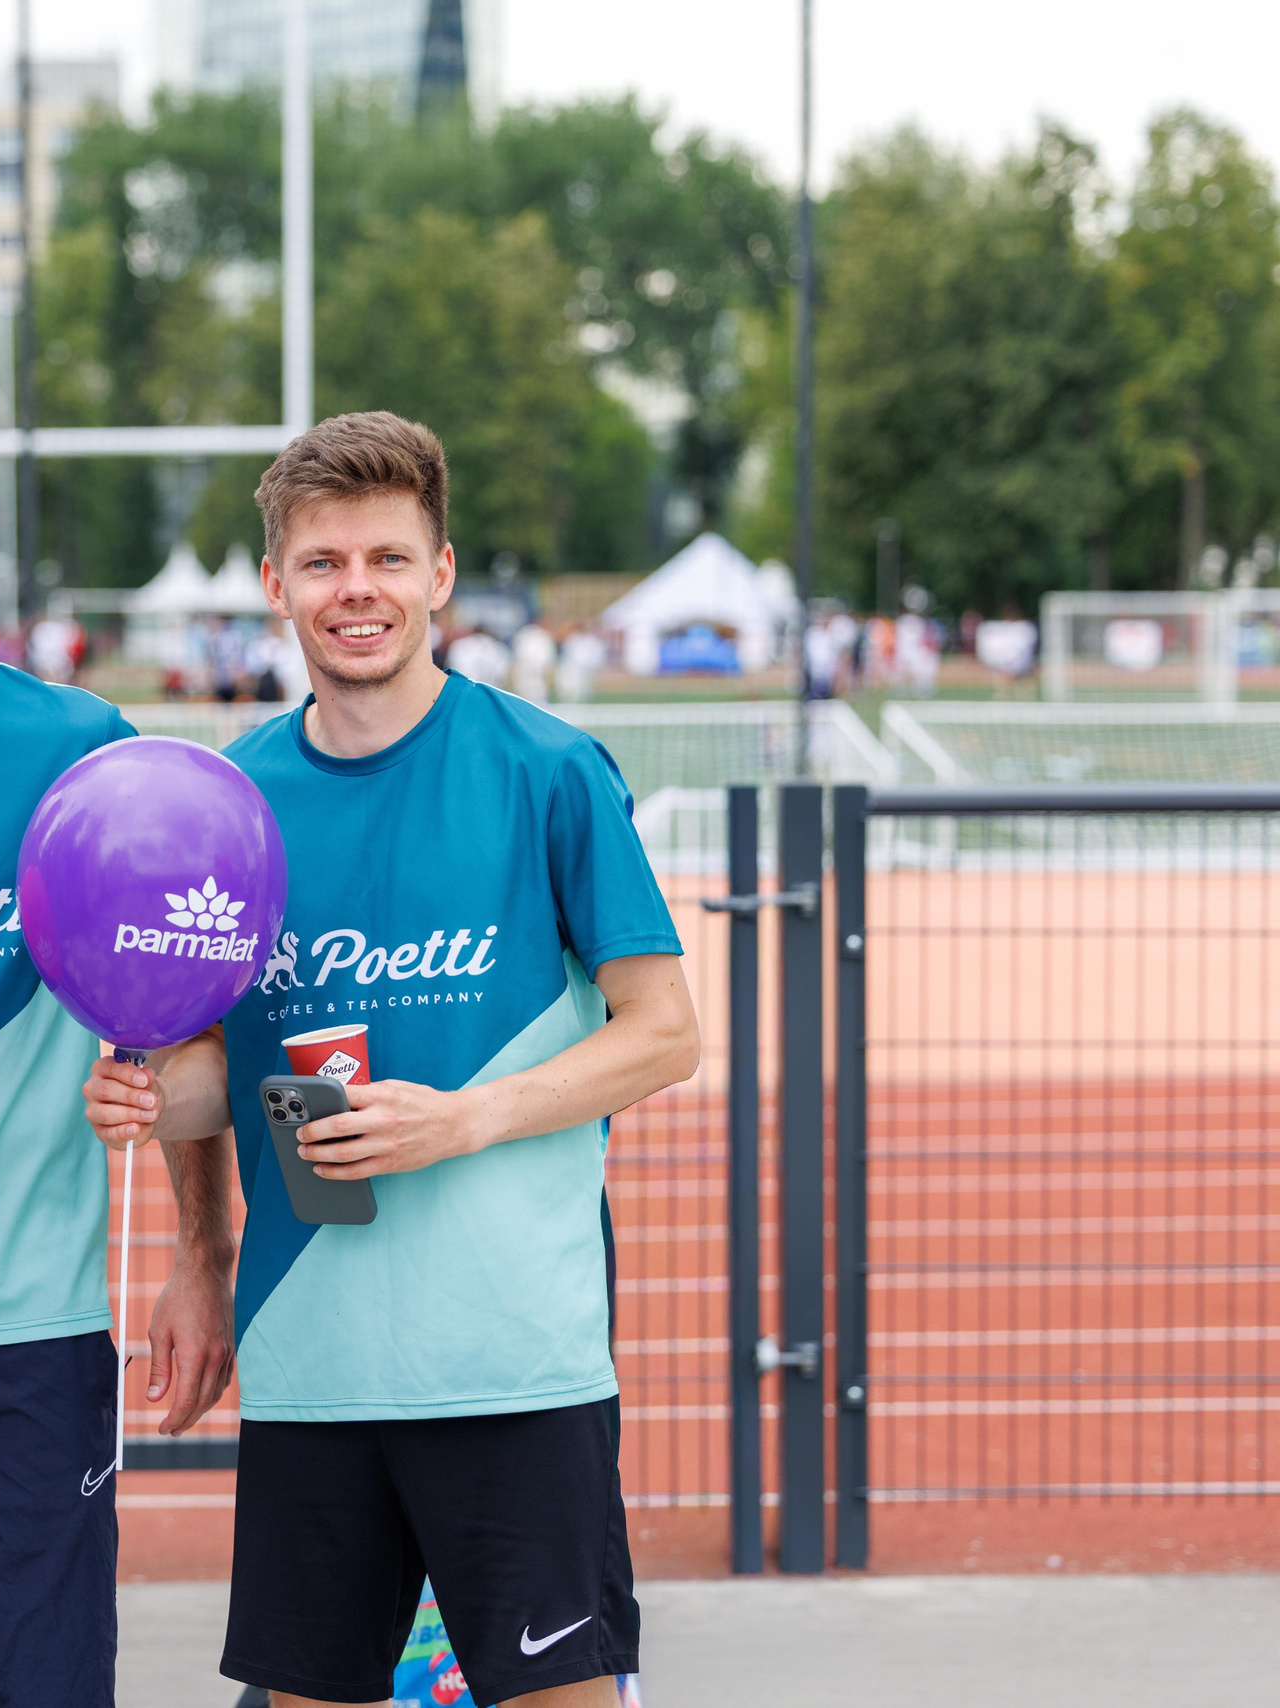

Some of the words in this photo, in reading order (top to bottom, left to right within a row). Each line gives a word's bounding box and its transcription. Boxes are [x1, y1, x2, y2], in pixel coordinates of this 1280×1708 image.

[113, 923, 259, 962] parmalat
[310, 924, 499, 987] Poetti
[326, 1002, 335, 1013] &
[346, 999, 379, 1011] TEA
[388, 991, 484, 1007] COMPANY
[322, 1060, 356, 1077] Poetti
